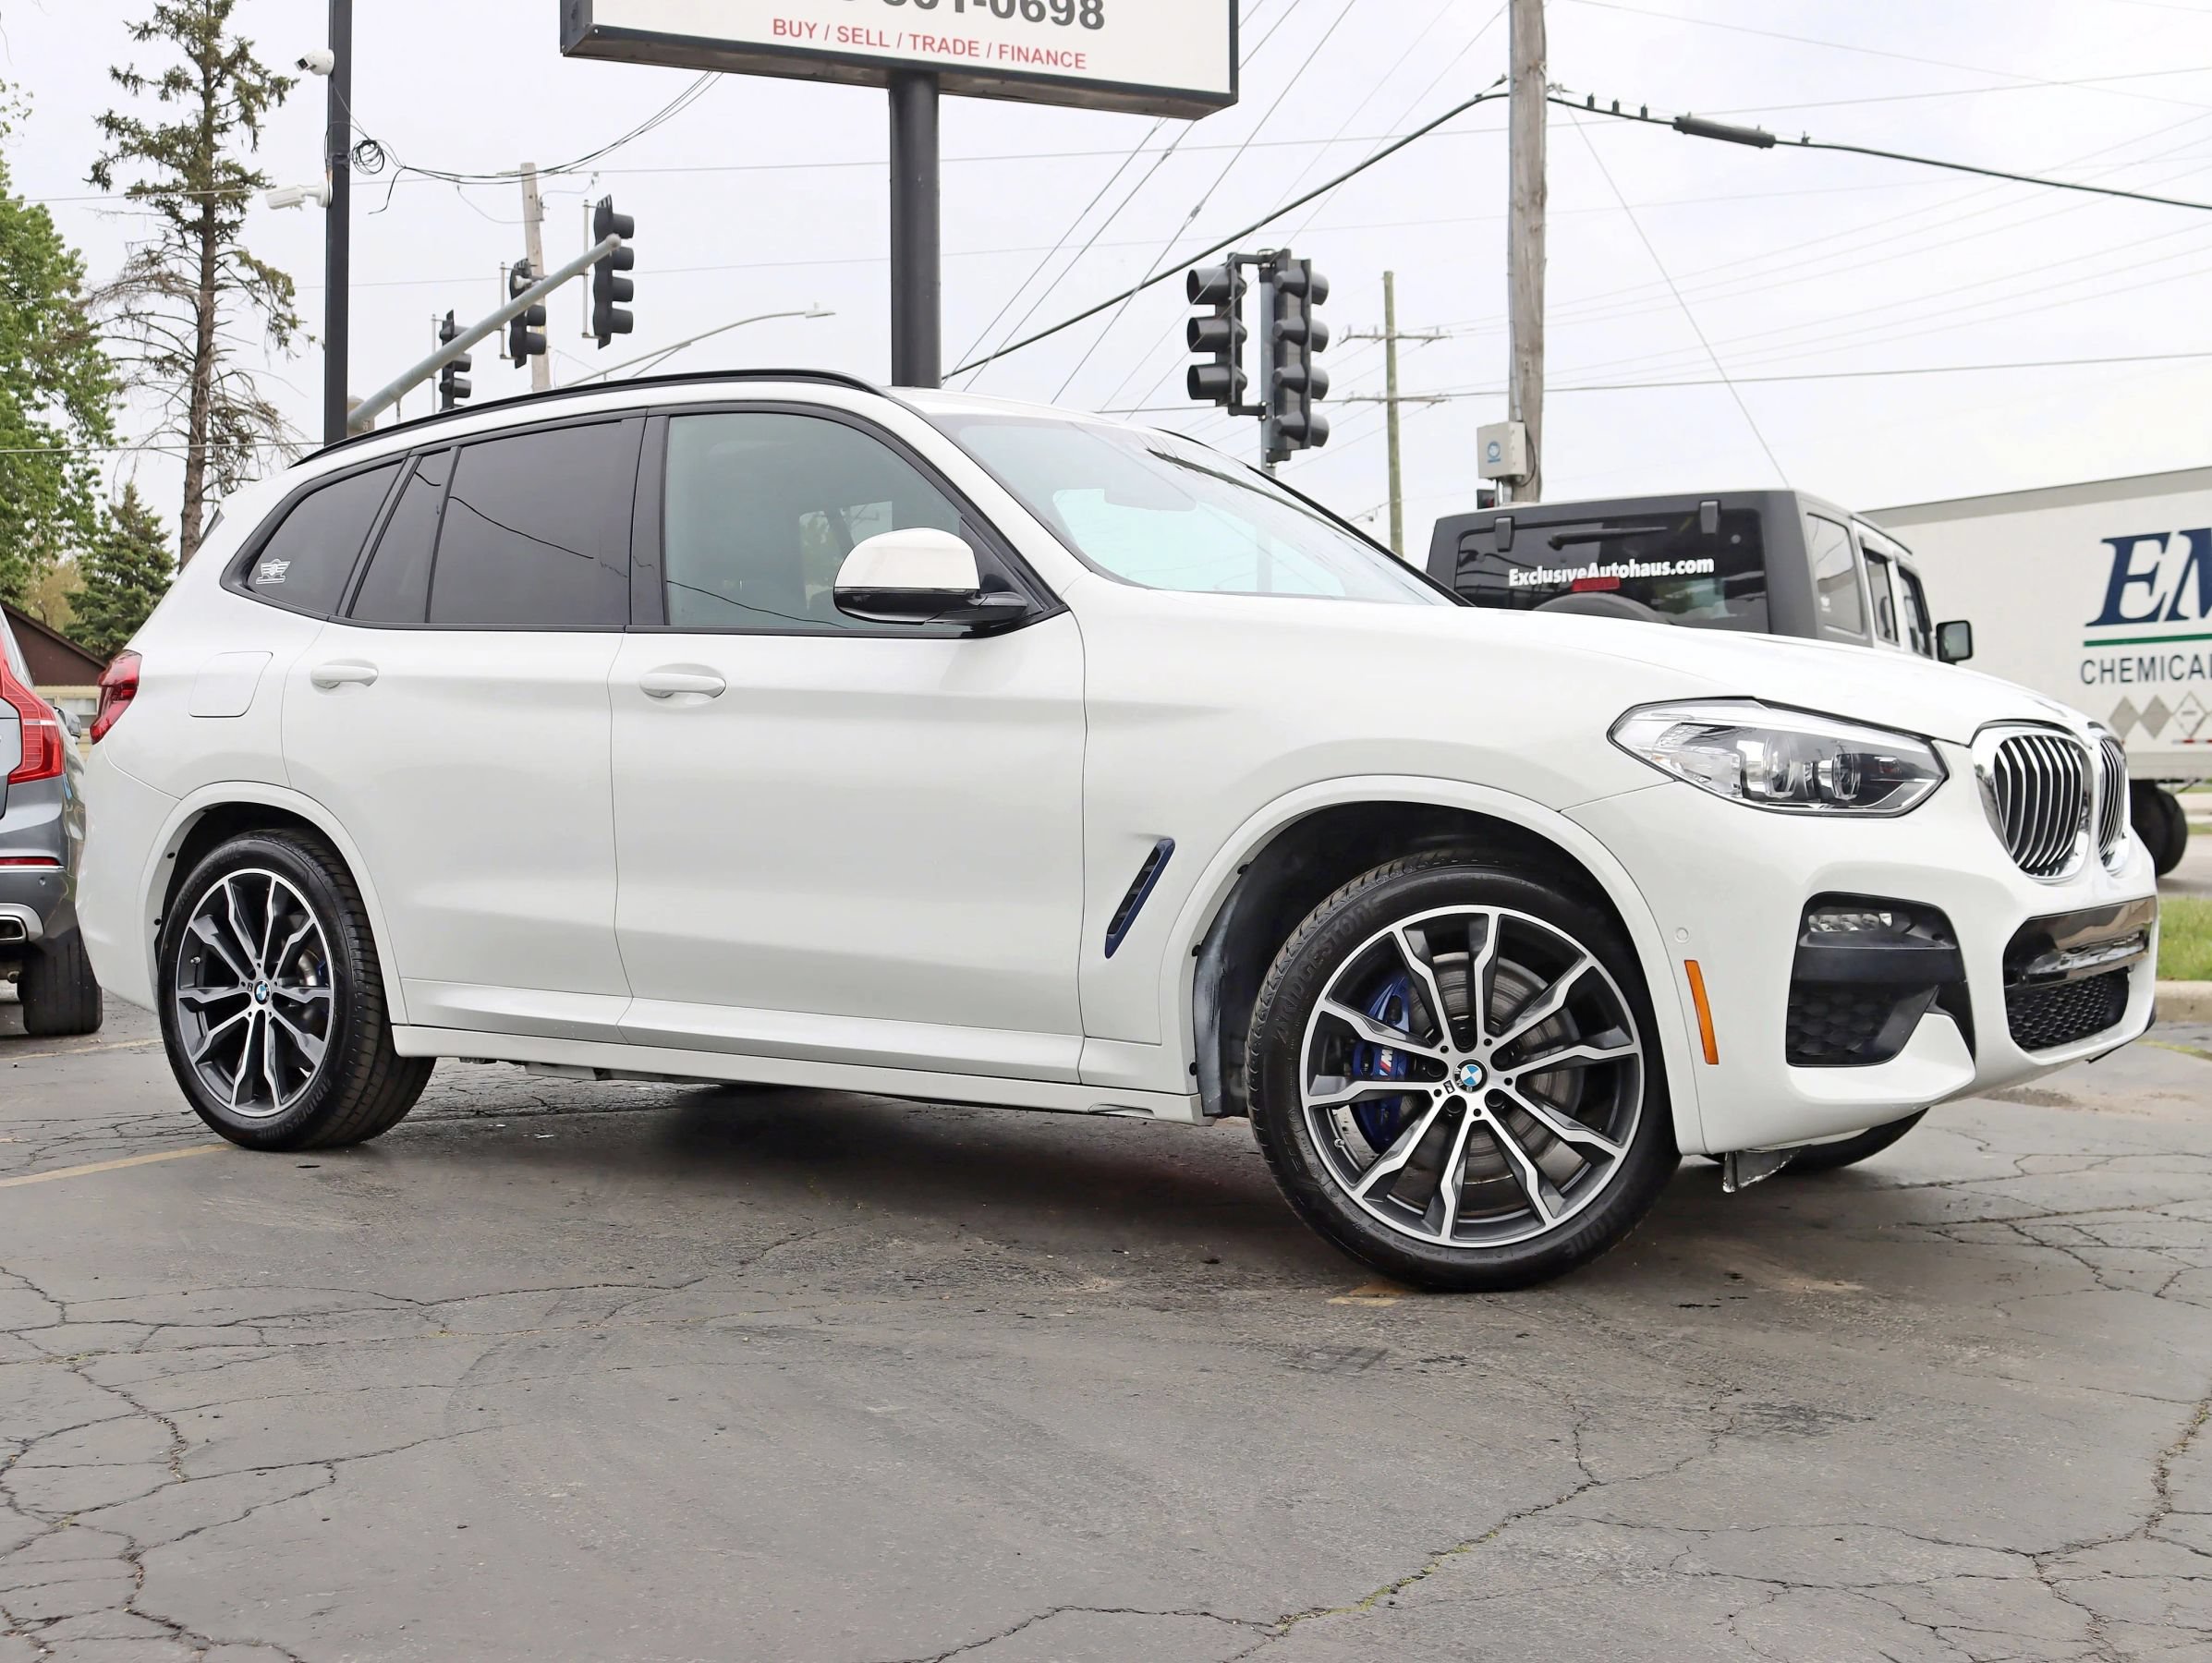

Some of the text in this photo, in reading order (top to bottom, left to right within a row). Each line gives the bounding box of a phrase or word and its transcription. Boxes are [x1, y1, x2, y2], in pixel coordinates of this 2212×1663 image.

[882, 0, 1105, 30] -0698
[772, 18, 1087, 69] BUY / SELL / TRADE / FINANCE
[1508, 556, 1715, 588] ExclusiveAutohaus.com
[2080, 654, 2212, 685] CHEMICA
